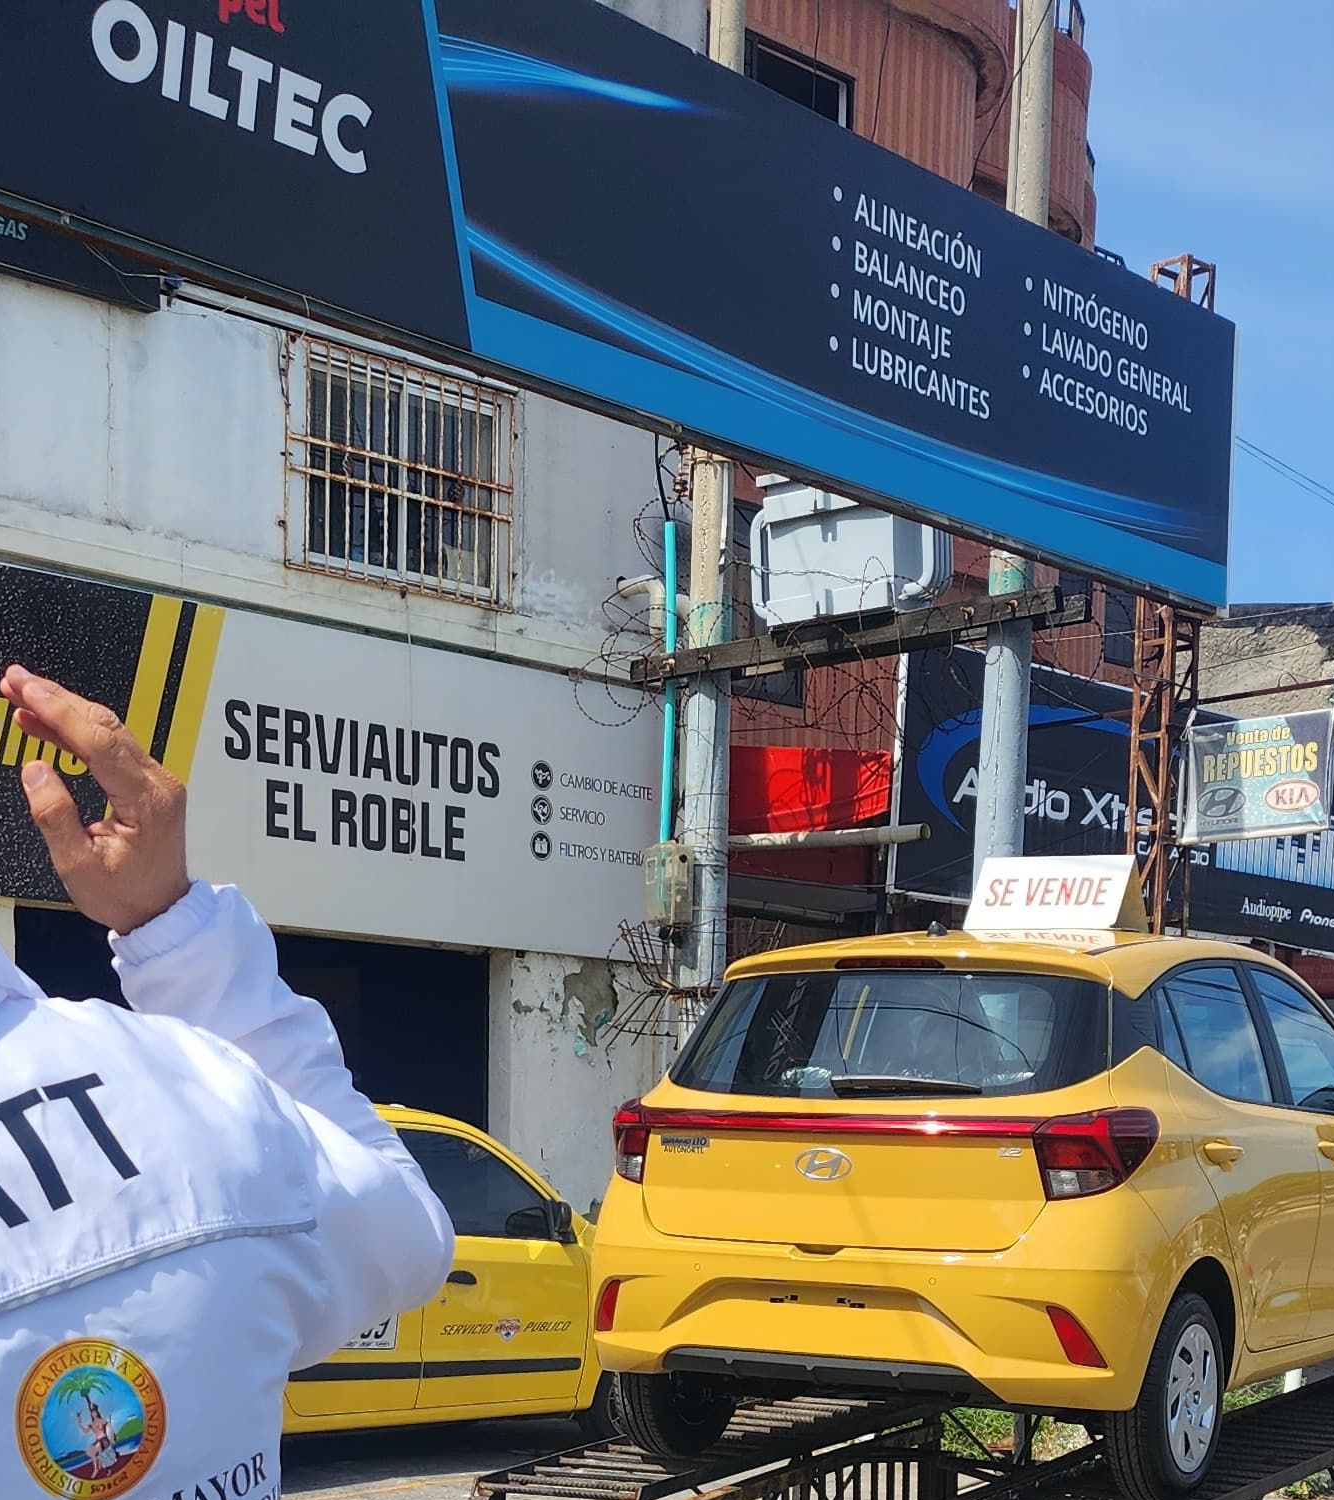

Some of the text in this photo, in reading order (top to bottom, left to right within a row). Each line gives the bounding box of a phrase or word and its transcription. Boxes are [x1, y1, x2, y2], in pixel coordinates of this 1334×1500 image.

[91, 0, 372, 173] OILTEC
[854, 193, 982, 278] ALINEACIÓN
[854, 240, 966, 317] BALANCEO
[853, 288, 952, 360] MONTAJE
[1042, 277, 1149, 351] NITRÓGENO
[851, 336, 991, 420] LUBRICANTES
[1042, 321, 1193, 414] LAVADO GENERAL
[1039, 366, 1149, 436] ACCESORIOS
[224, 698, 501, 799] SERVIAUTOS
[1203, 741, 1319, 784] REPUESTOS
[1226, 725, 1291, 748] Venta de
[559, 772, 653, 801] CAMBIO DE ACEITE
[559, 806, 606, 826] SERVICIO
[952, 766, 1071, 822] Adio
[1274, 788, 1310, 806] KIA
[266, 778, 467, 862] EL ROBLE
[1199, 817, 1239, 828] HYUNDAI
[559, 842, 598, 861] FILTROS
[598, 848, 607, 862] Y
[984, 877, 1019, 908] SE
[1025, 876, 1113, 908] VENDE
[1239, 896, 1292, 923] Audiopipe
[439, 1323, 493, 1337] SERVICIO
[523, 1320, 571, 1333] PUBLICO
[25, 1349, 160, 1495] DISTRITO DE CARTAGENA DE INDIAS
